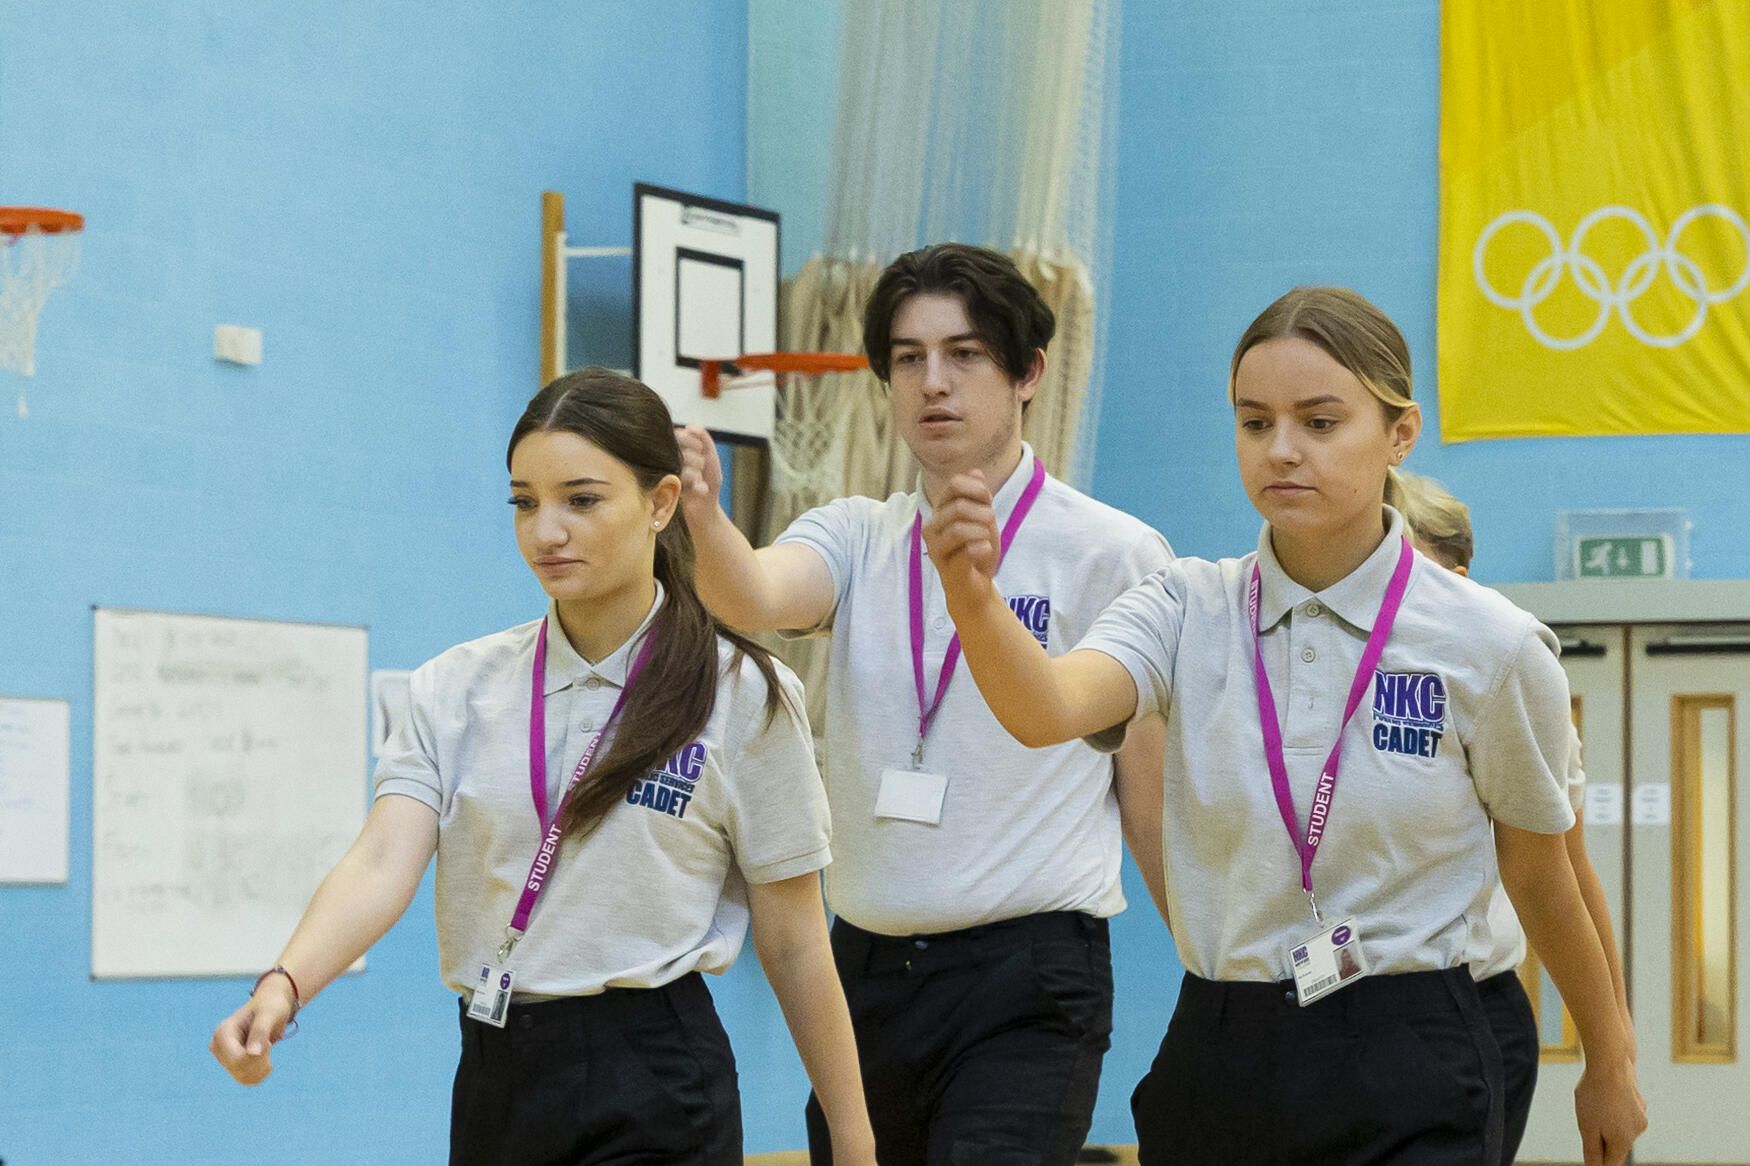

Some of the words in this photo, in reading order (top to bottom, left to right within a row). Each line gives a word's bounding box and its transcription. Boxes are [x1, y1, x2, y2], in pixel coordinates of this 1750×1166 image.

[1374, 670, 1446, 722] NKC
[1373, 723, 1443, 758] CADET
[626, 780, 691, 818] CADET
[1307, 771, 1334, 846] STUDENT
[528, 823, 562, 892] STUDENT
